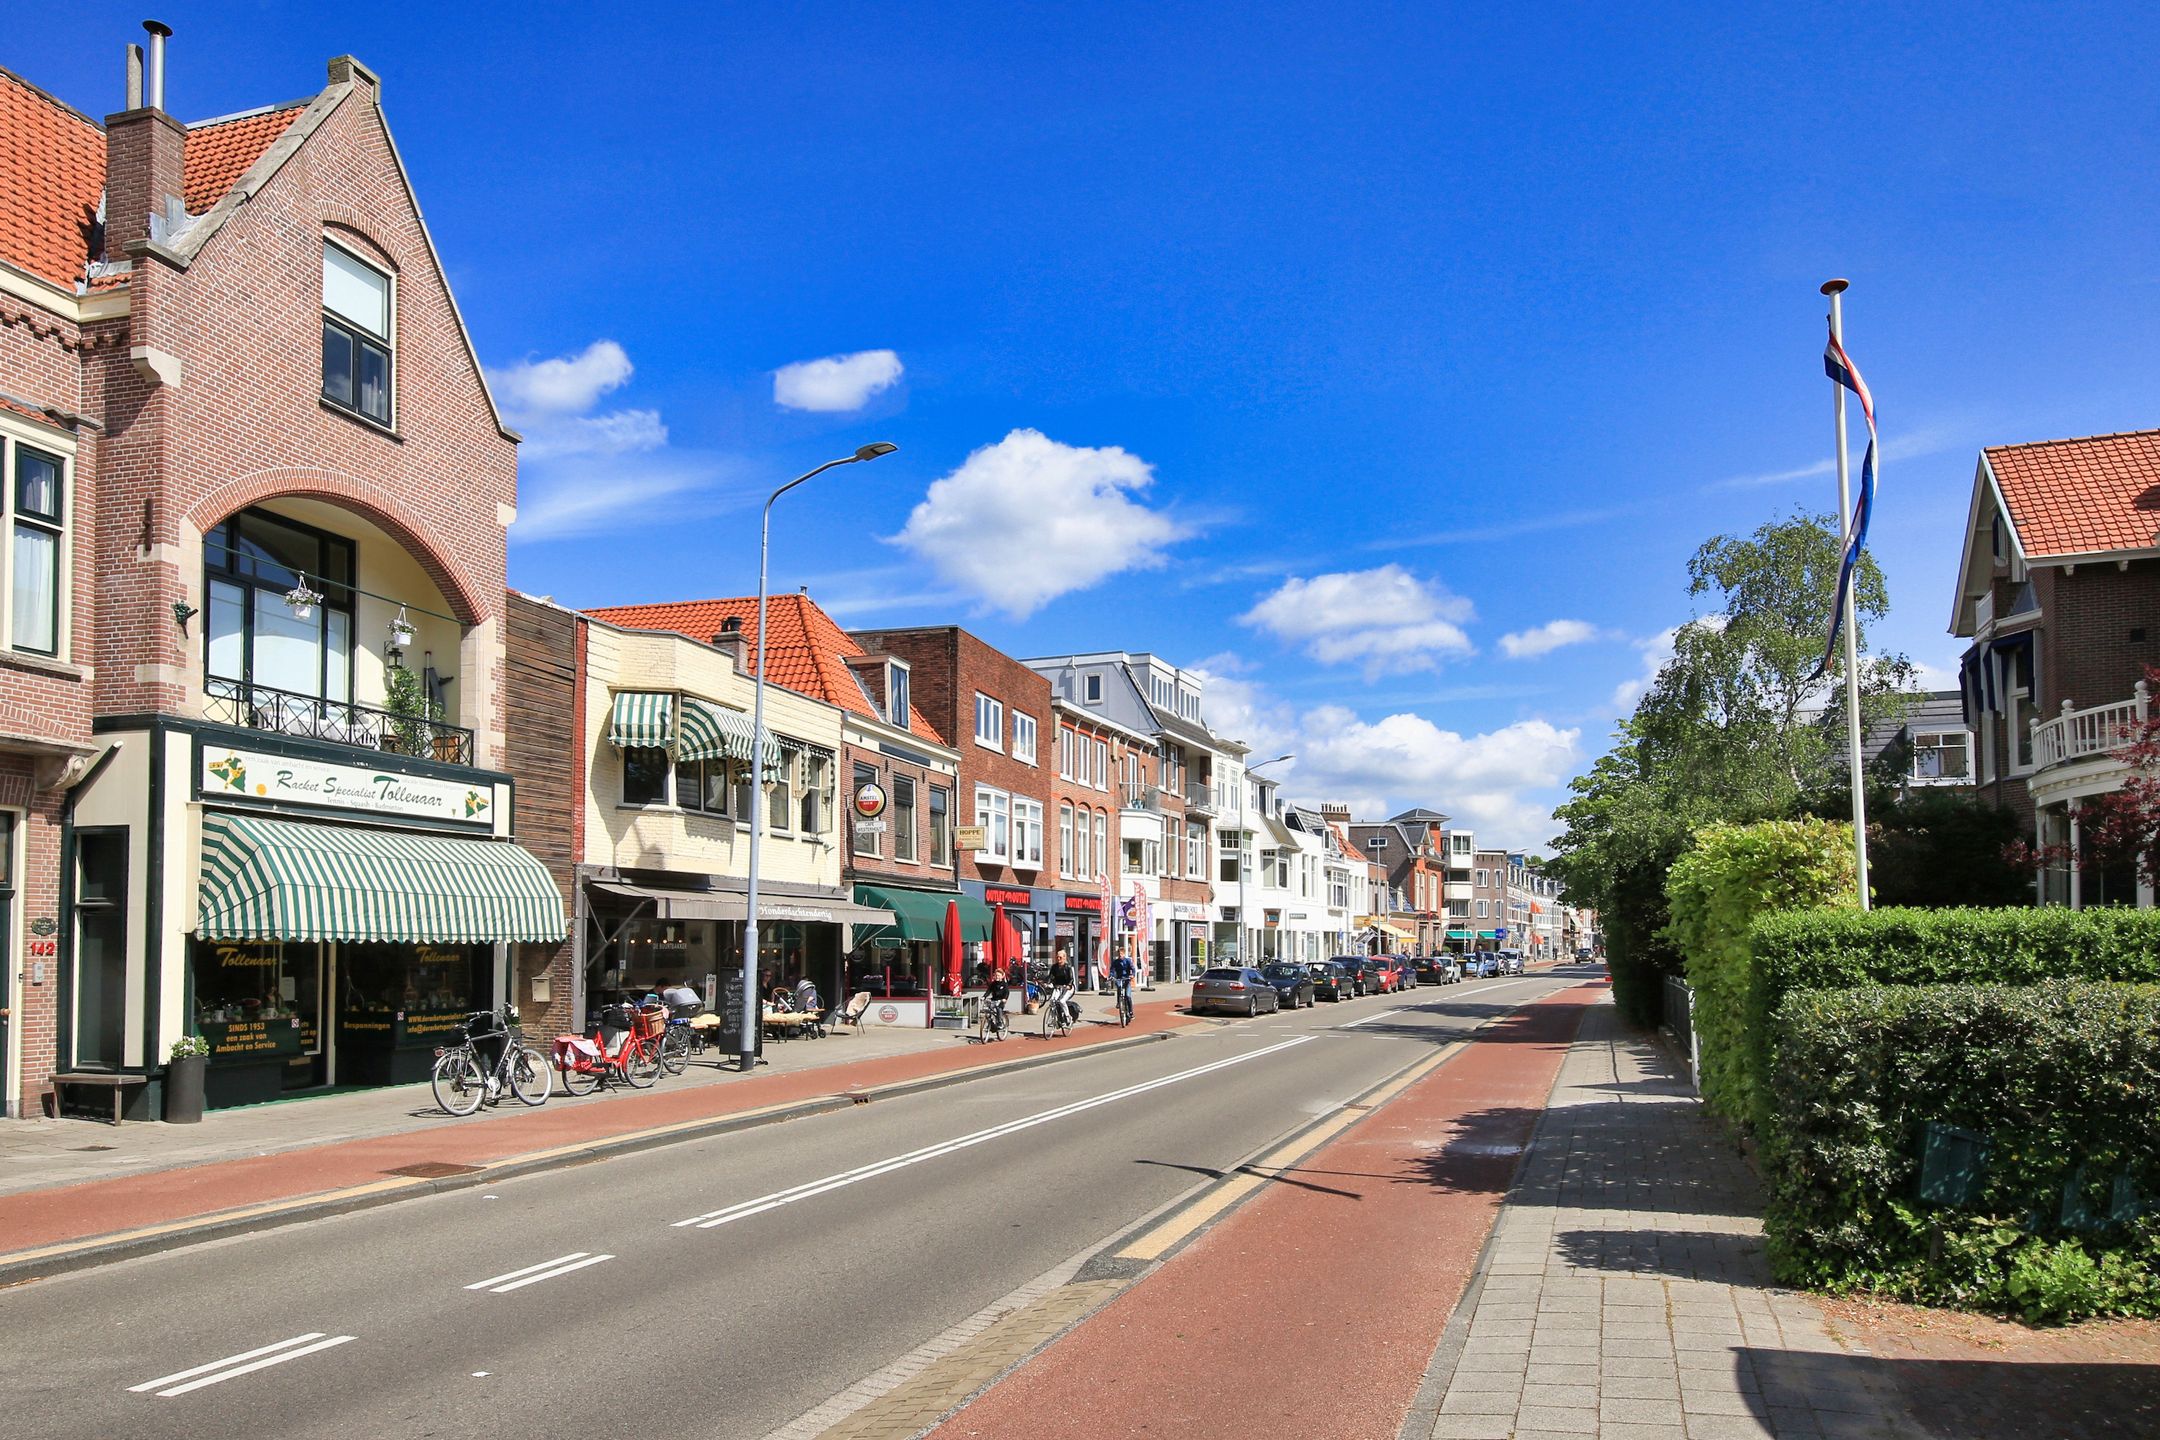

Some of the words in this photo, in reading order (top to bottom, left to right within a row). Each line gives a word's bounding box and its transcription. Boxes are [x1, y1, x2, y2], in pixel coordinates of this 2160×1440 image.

[276, 770, 319, 792] Racket
[323, 777, 376, 799] Specialist
[373, 775, 443, 807] Tollenaar
[350, 800, 370, 808] Squash
[986, 889, 1005, 902] OUTLET
[1012, 892, 1030, 904] OUTLET
[30, 942, 55, 956] 142
[415, 945, 460, 963] Tollenaar
[216, 947, 278, 967] Tollenaar
[228, 1023, 248, 1033] SINDS
[250, 1023, 265, 1031] 1953
[239, 1033, 254, 1041] zaak
[216, 1044, 244, 1053] Ambacht
[254, 1041, 276, 1049] Service
